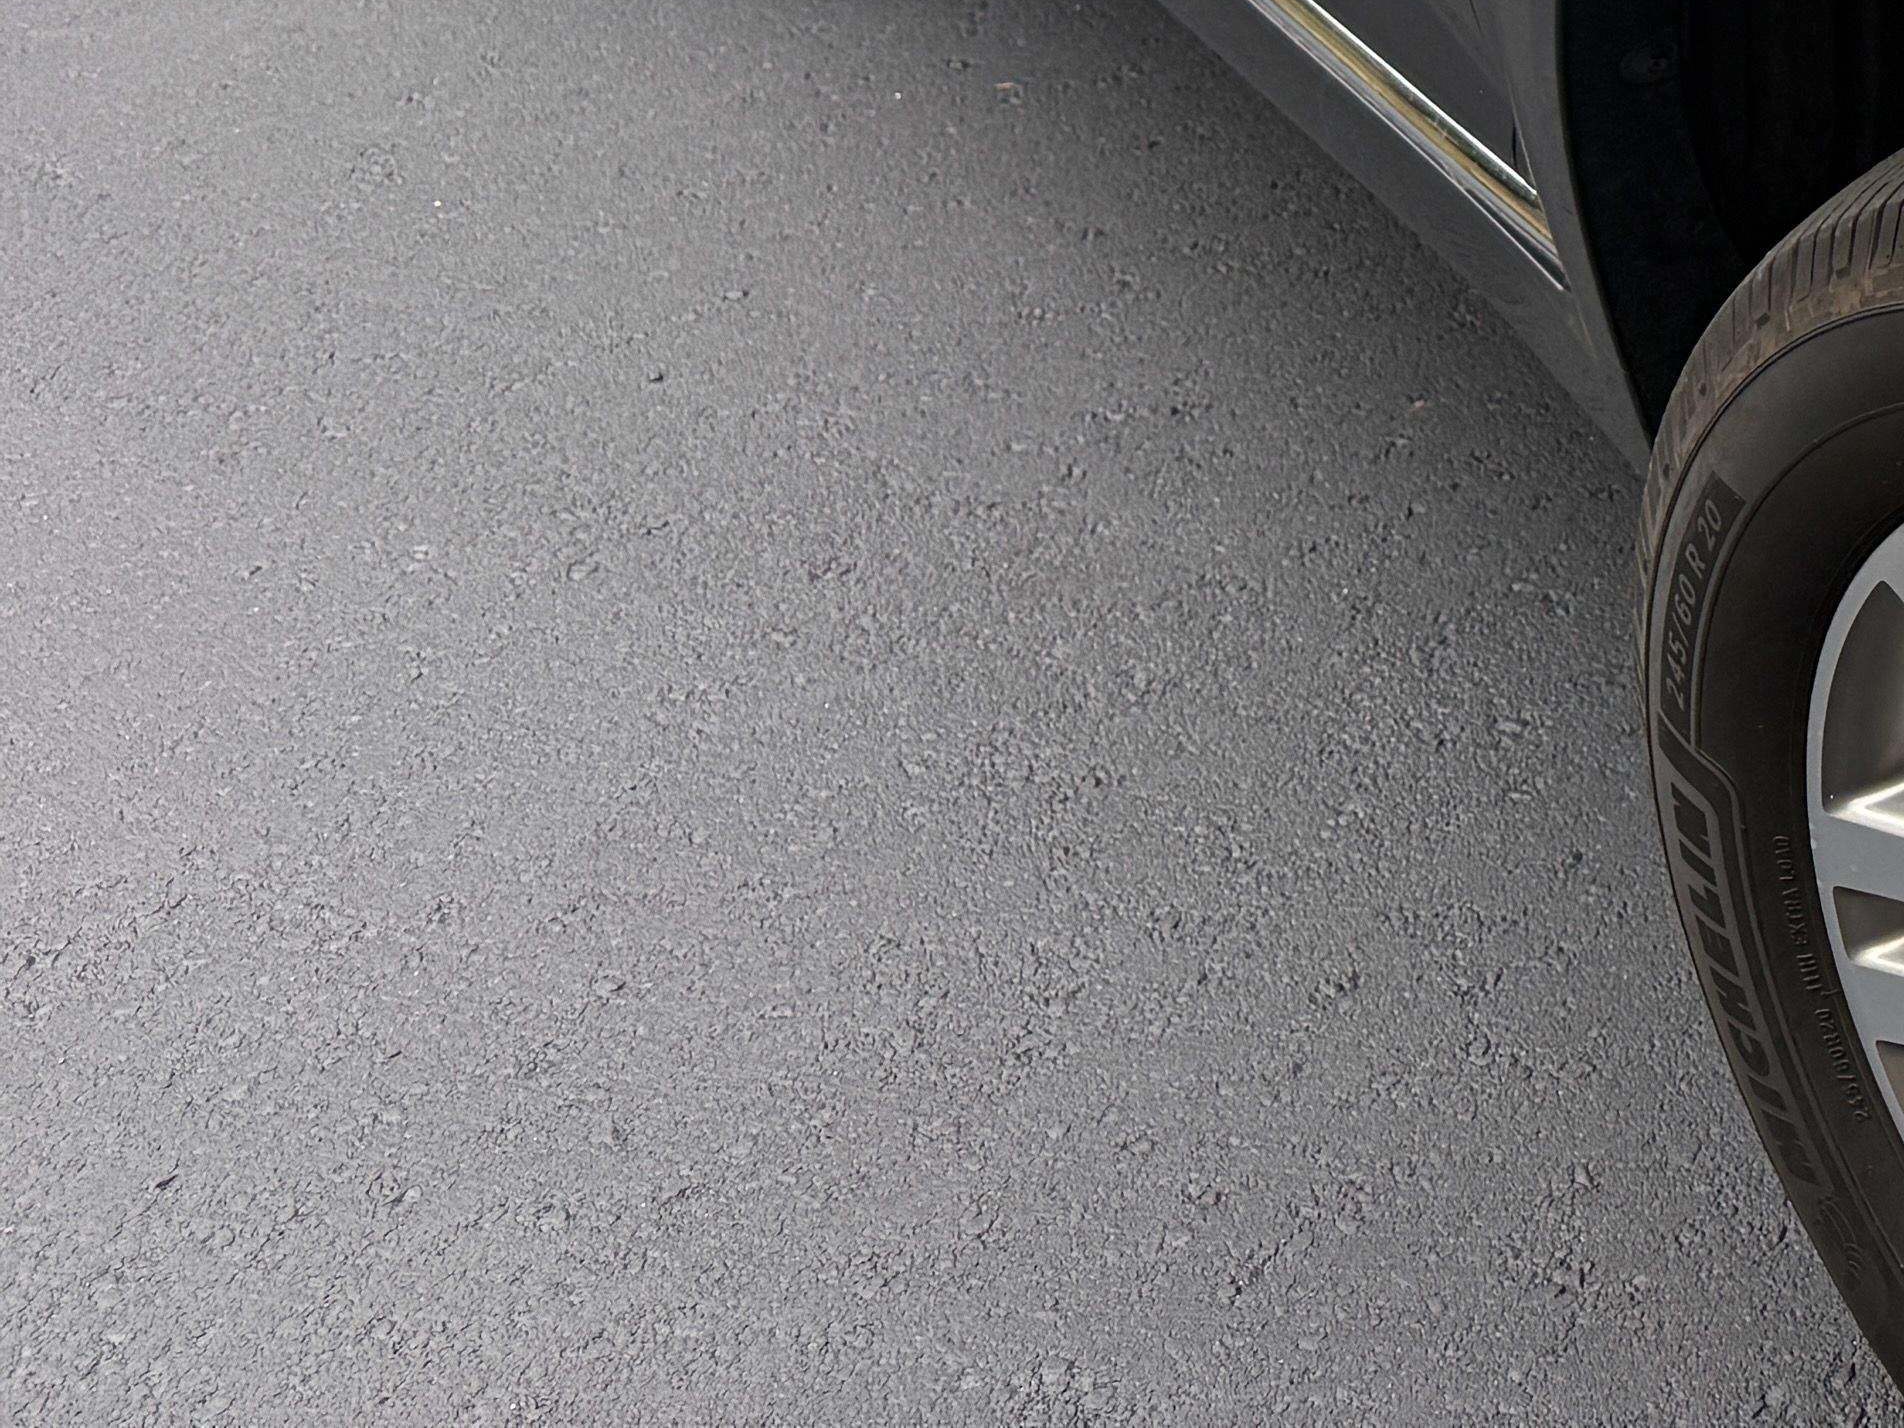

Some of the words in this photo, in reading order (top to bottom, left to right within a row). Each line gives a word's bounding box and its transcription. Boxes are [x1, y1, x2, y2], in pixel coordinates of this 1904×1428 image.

[1665, 573, 1697, 712] 245/60
[1685, 544, 1706, 579] R
[1697, 498, 1723, 552] 20
[1668, 781, 1822, 1187] MICHELIN
